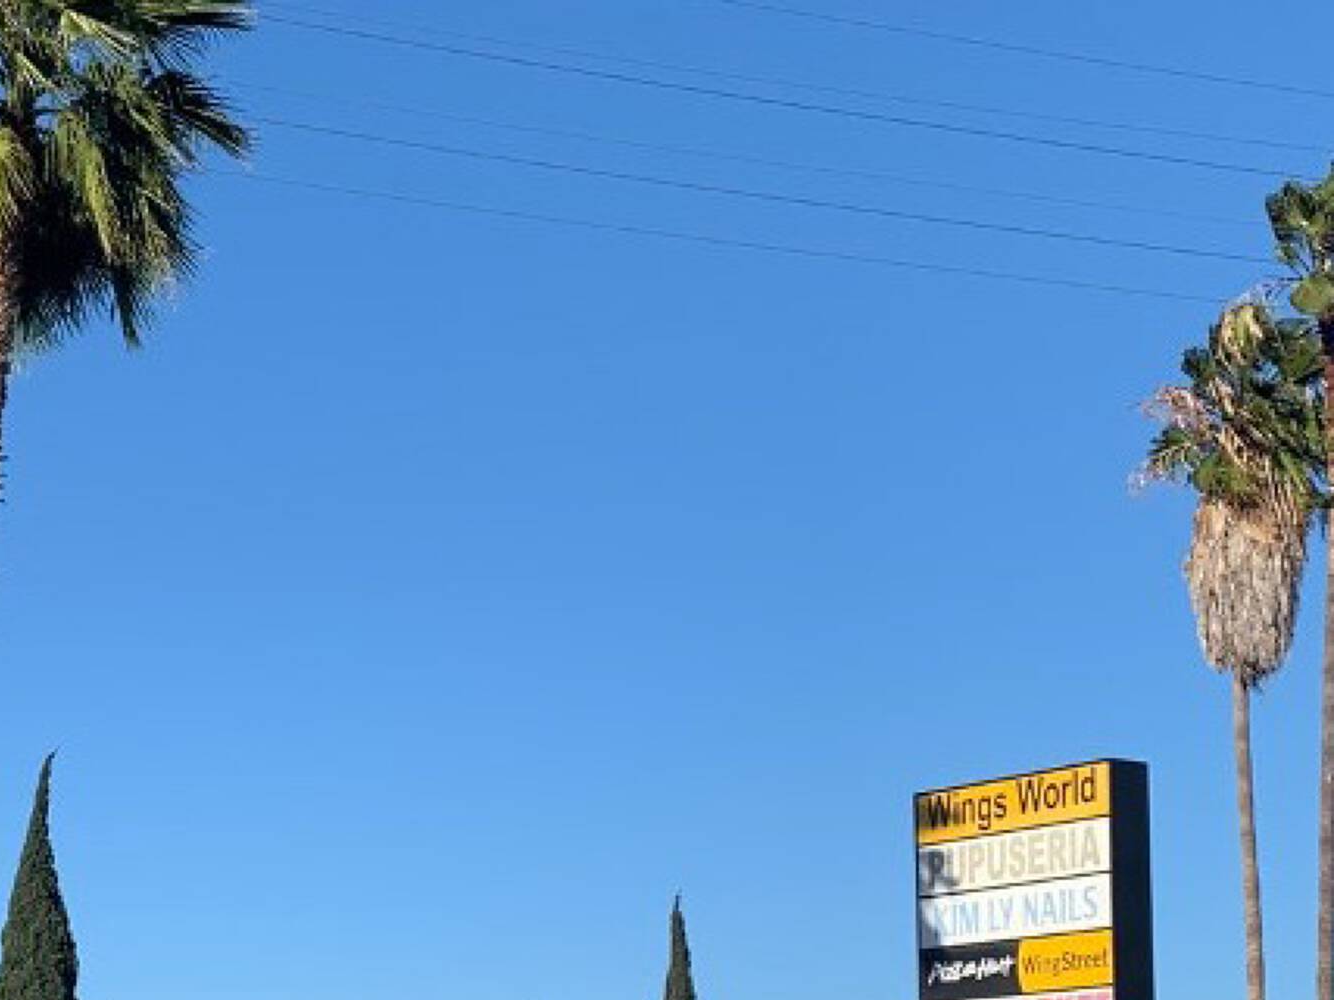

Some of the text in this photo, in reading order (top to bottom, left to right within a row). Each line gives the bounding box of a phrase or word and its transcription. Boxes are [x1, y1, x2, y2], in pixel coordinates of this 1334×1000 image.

[925, 766, 1098, 831] Wings World
[928, 826, 1100, 890] PUPUSERIA
[990, 896, 1014, 931] LY
[1023, 885, 1098, 928] NAILS
